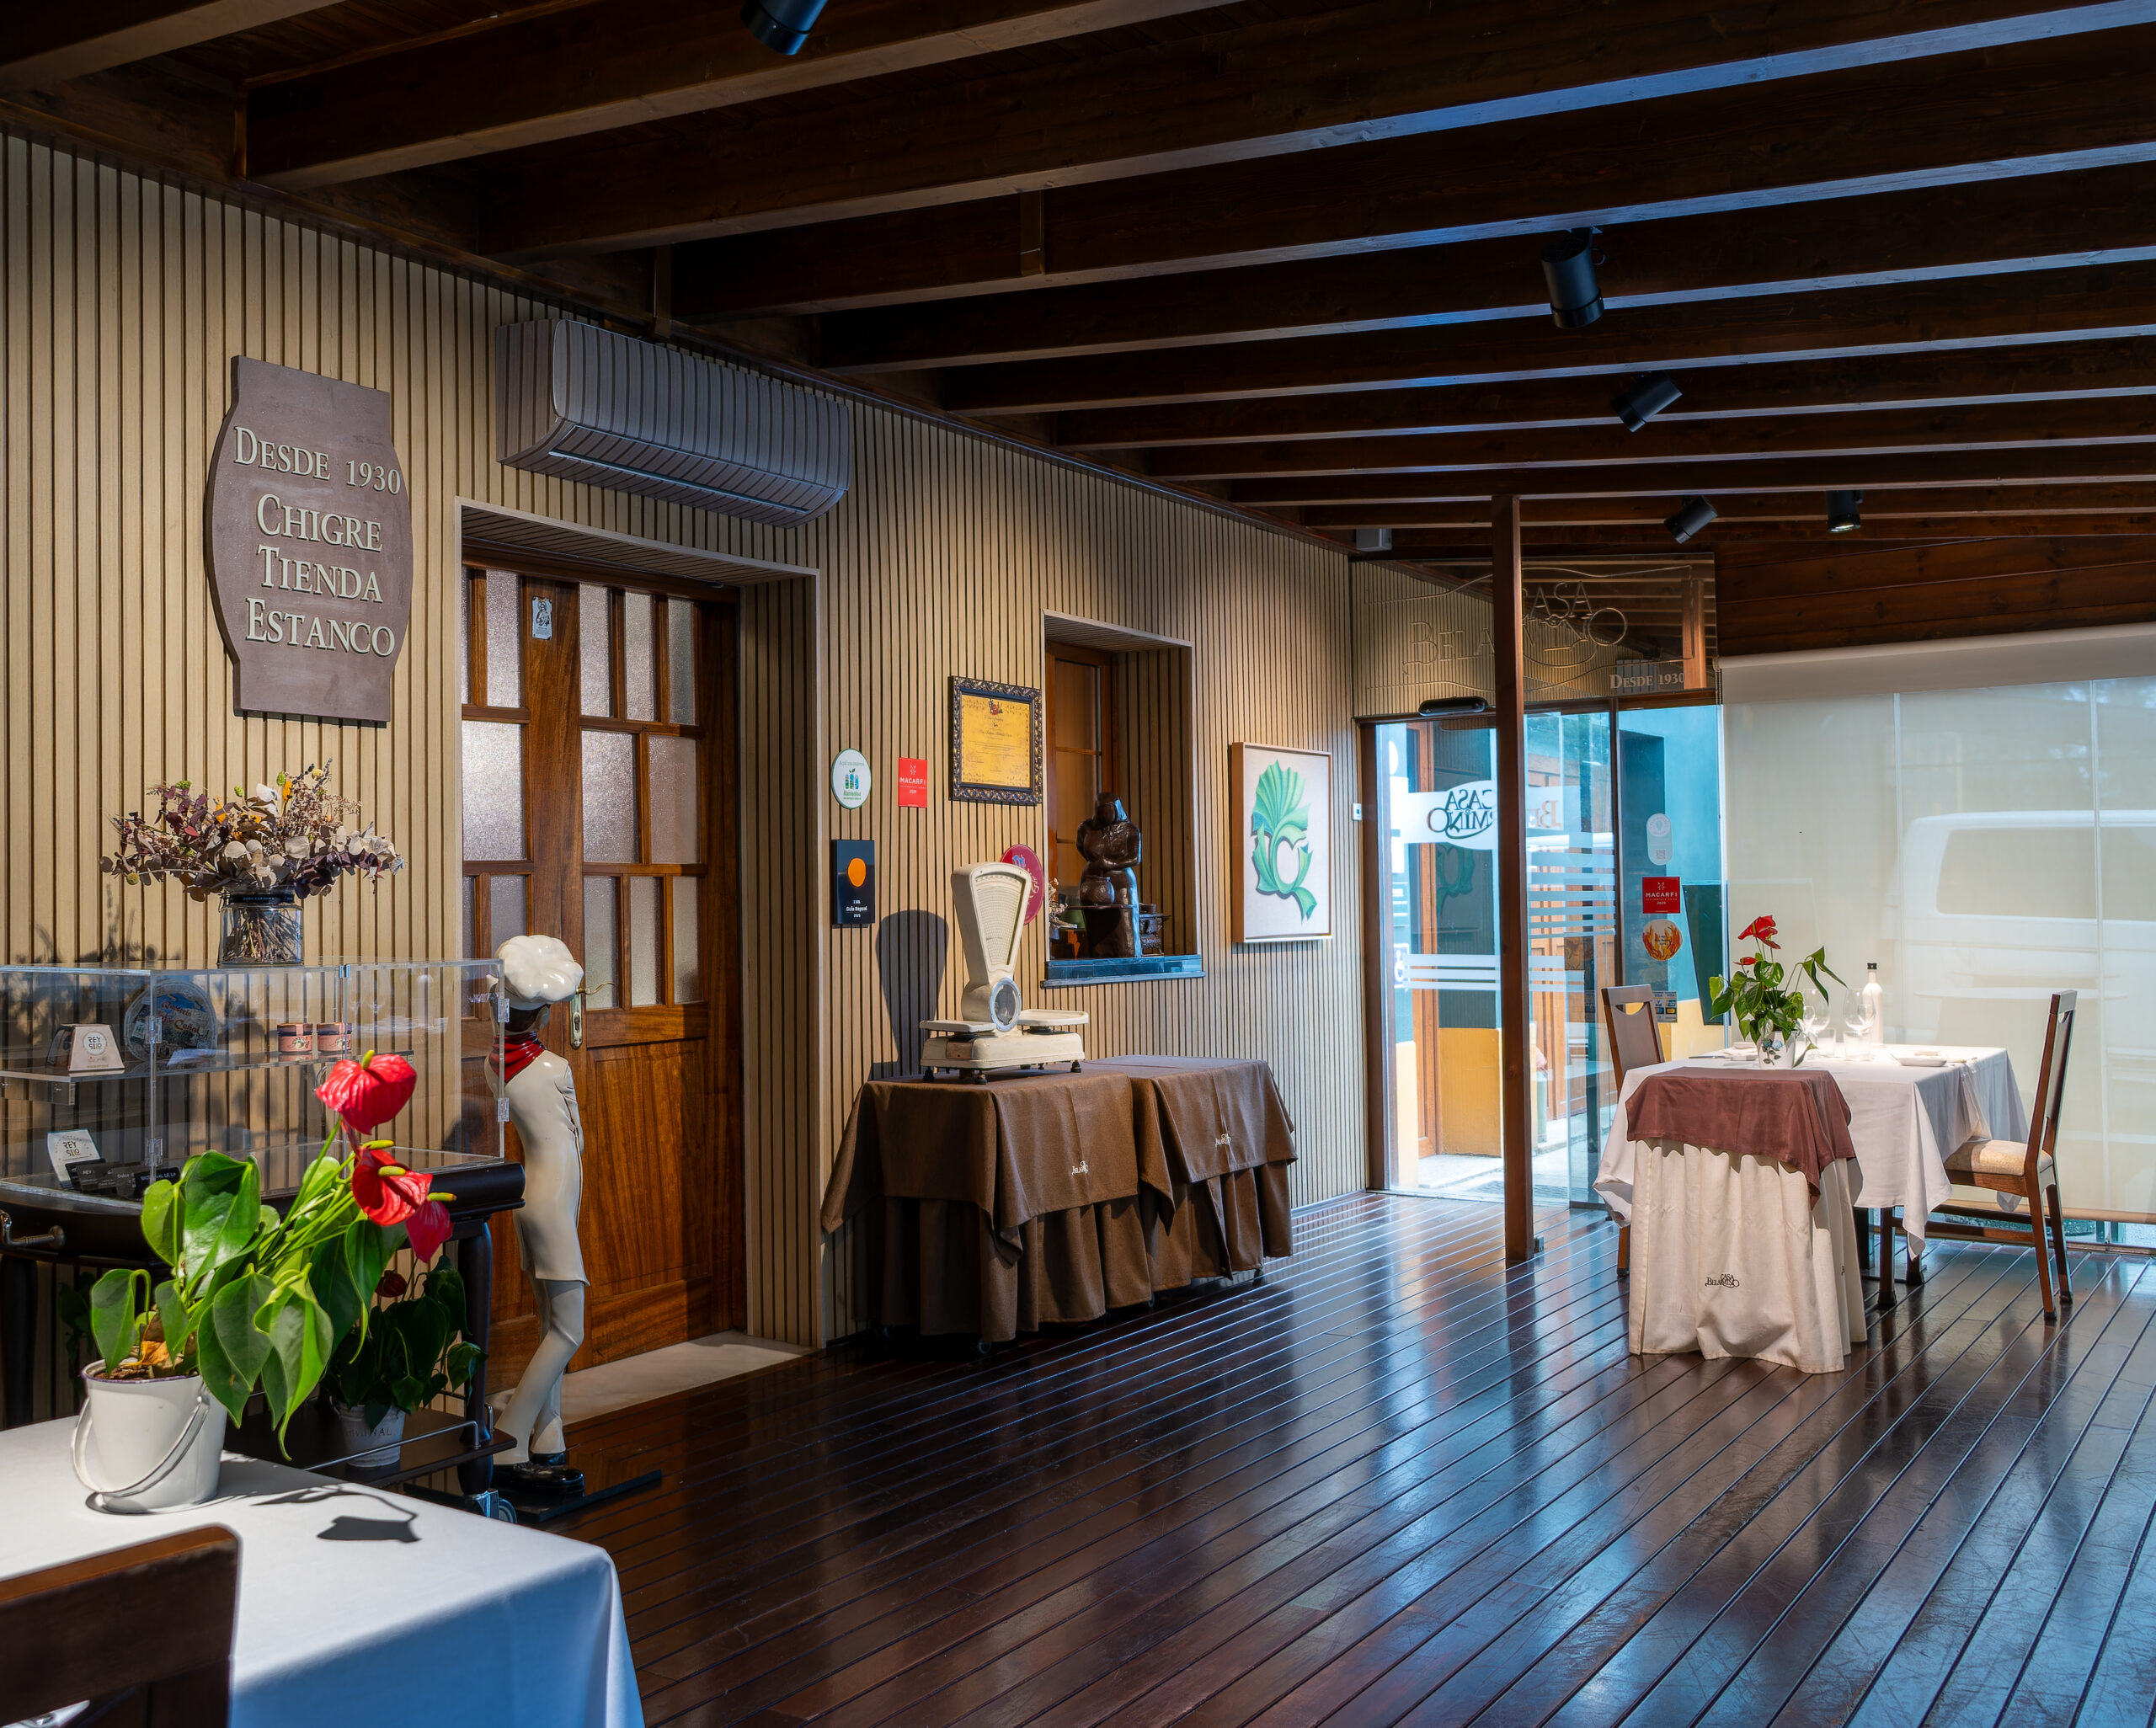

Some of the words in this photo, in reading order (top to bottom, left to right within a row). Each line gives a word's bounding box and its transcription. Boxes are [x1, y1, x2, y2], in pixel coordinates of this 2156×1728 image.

[234, 425, 331, 481] DESDE
[346, 460, 401, 495] 1930
[257, 493, 382, 552] CHIGRE
[256, 544, 383, 604] TIENDA
[245, 597, 395, 658] ESTANCO
[1609, 674, 1653, 689] DESDE
[1657, 672, 1685, 685] 1930
[899, 776, 926, 785] MACARFI
[62, 1141, 77, 1149] REY
